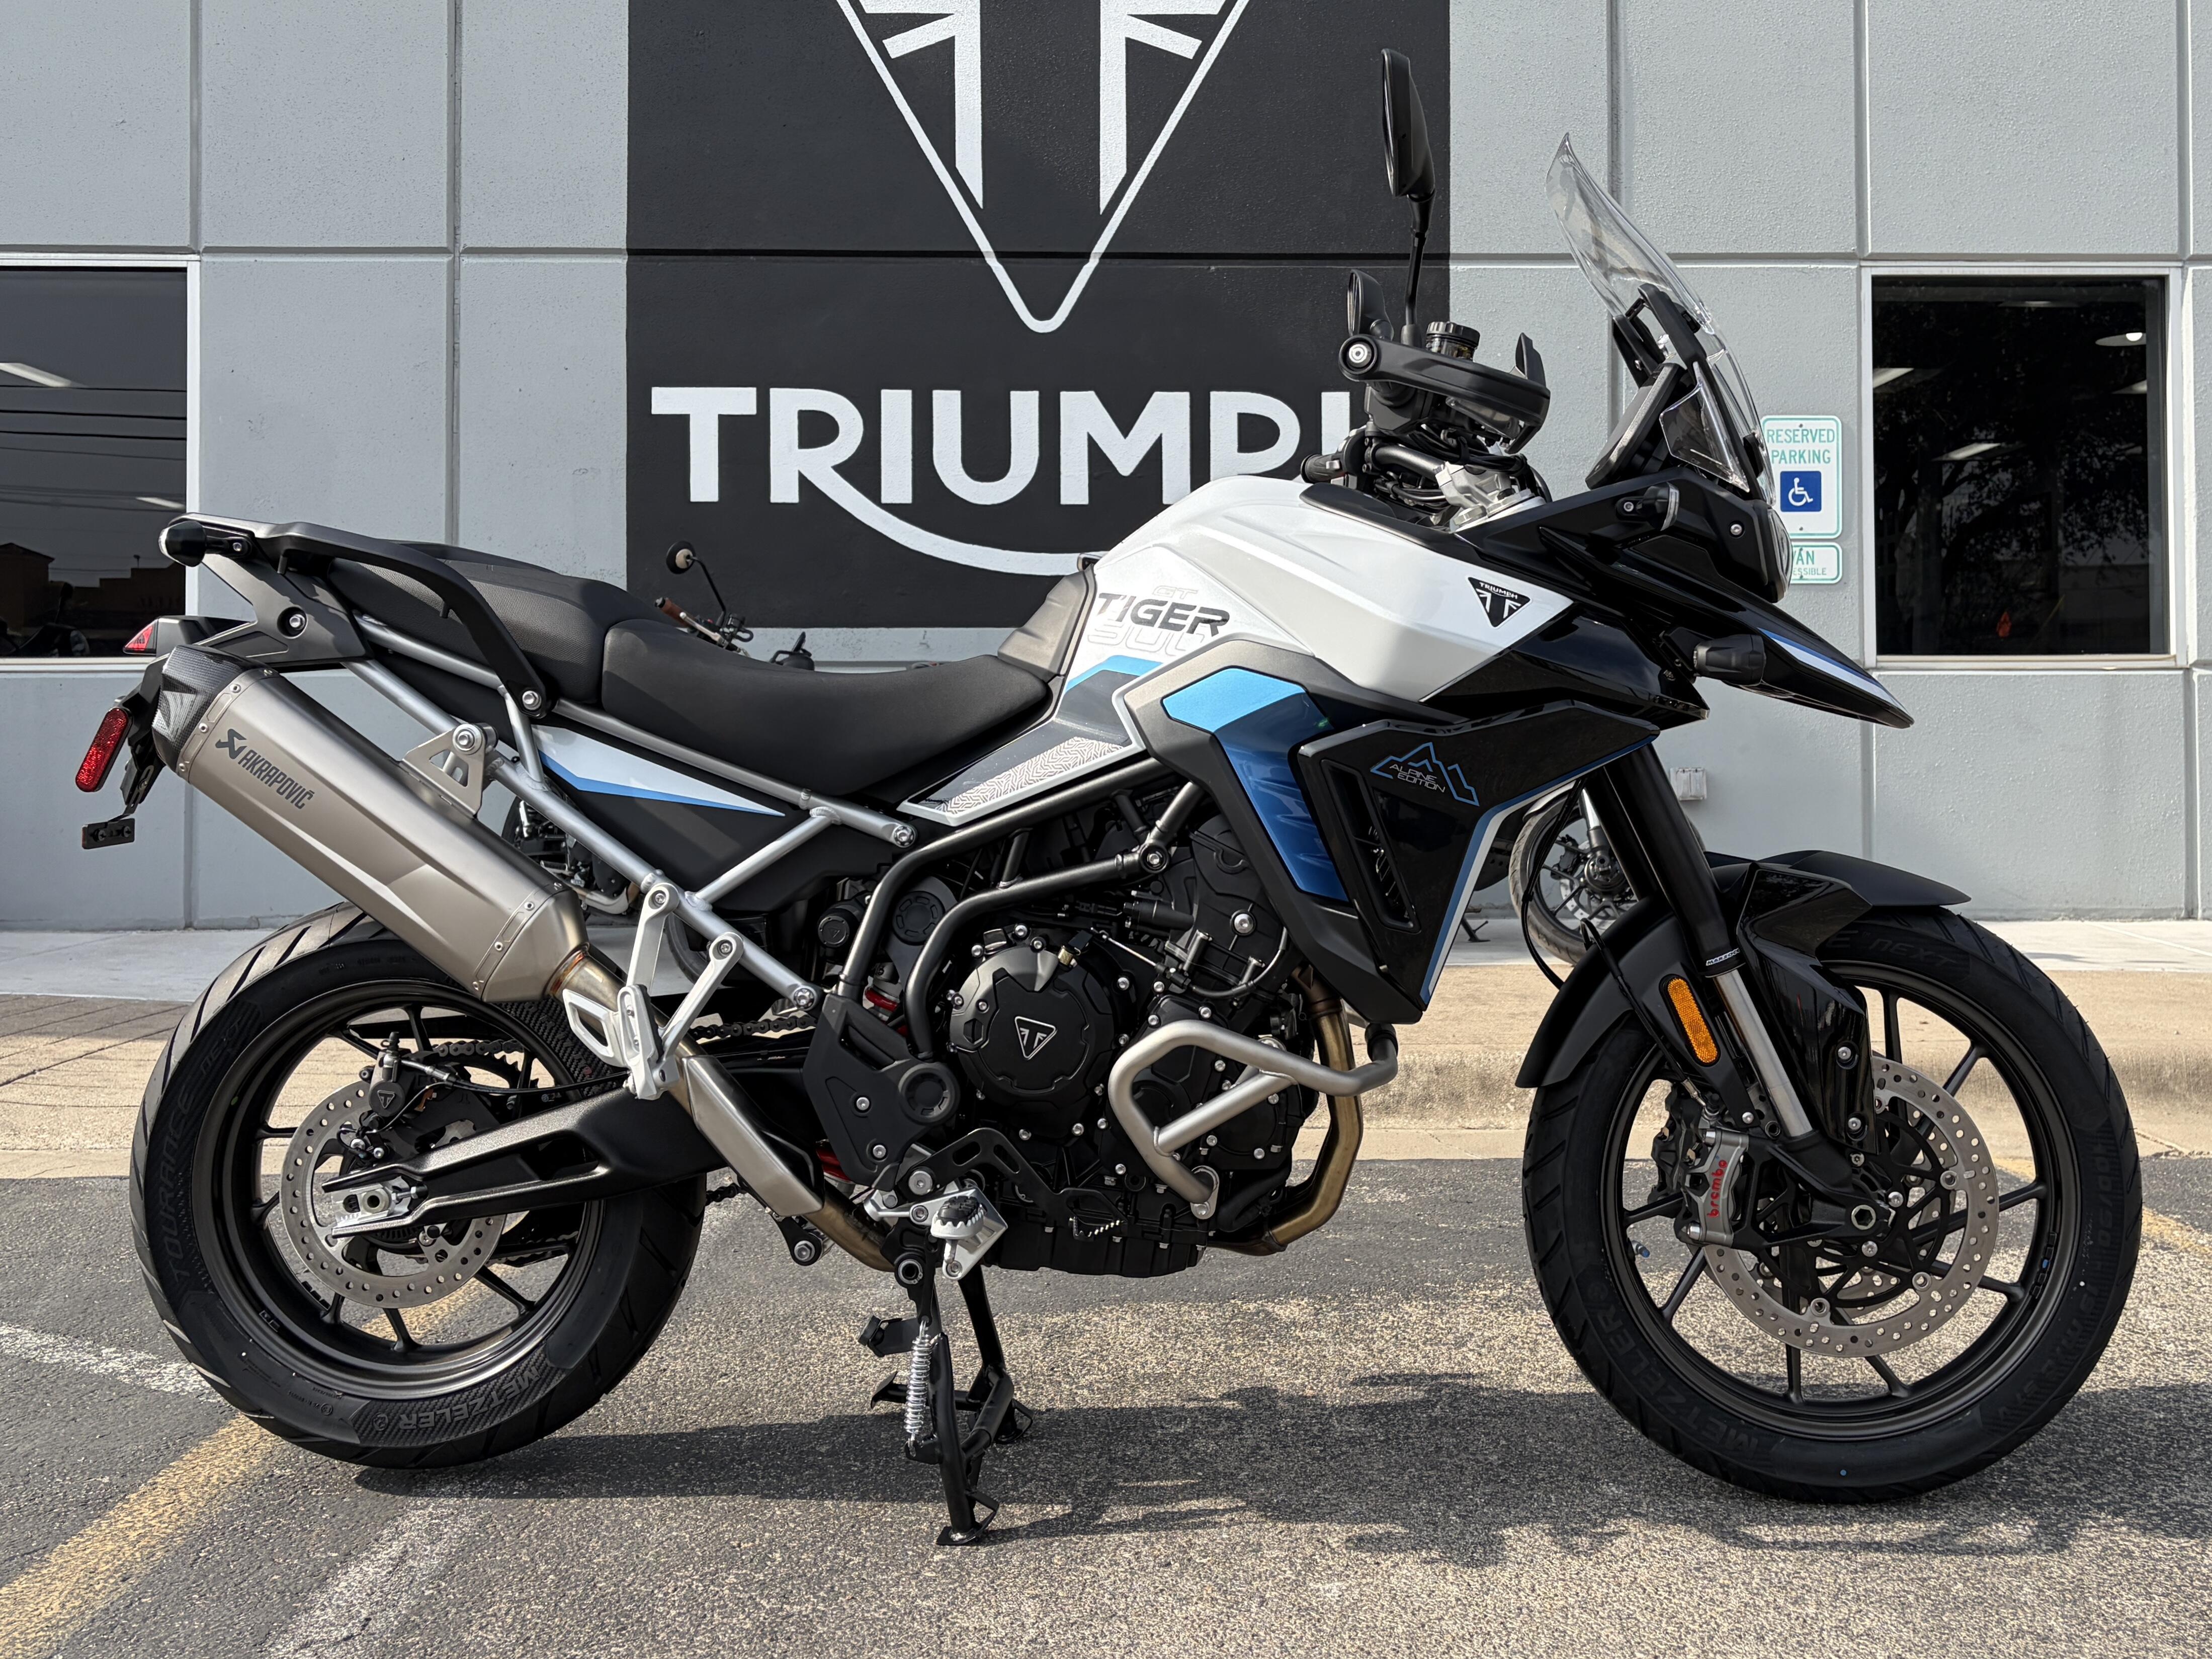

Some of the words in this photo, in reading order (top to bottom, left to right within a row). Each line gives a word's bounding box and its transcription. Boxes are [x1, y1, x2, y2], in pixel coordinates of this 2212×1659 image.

[1767, 429, 1835, 444] RESERVED
[1771, 449, 1831, 464] PARKING
[1152, 585, 1198, 599] GT
[1479, 582, 1518, 600] TRIUMPH
[1097, 593, 1230, 637] TIGER
[1389, 764, 1437, 783] ALPINE
[1397, 773, 1445, 793] EDITION
[1707, 1159, 1727, 1218] brembo
[1597, 1304, 1760, 1455] METZELER
[400, 1364, 541, 1430] METZELER
